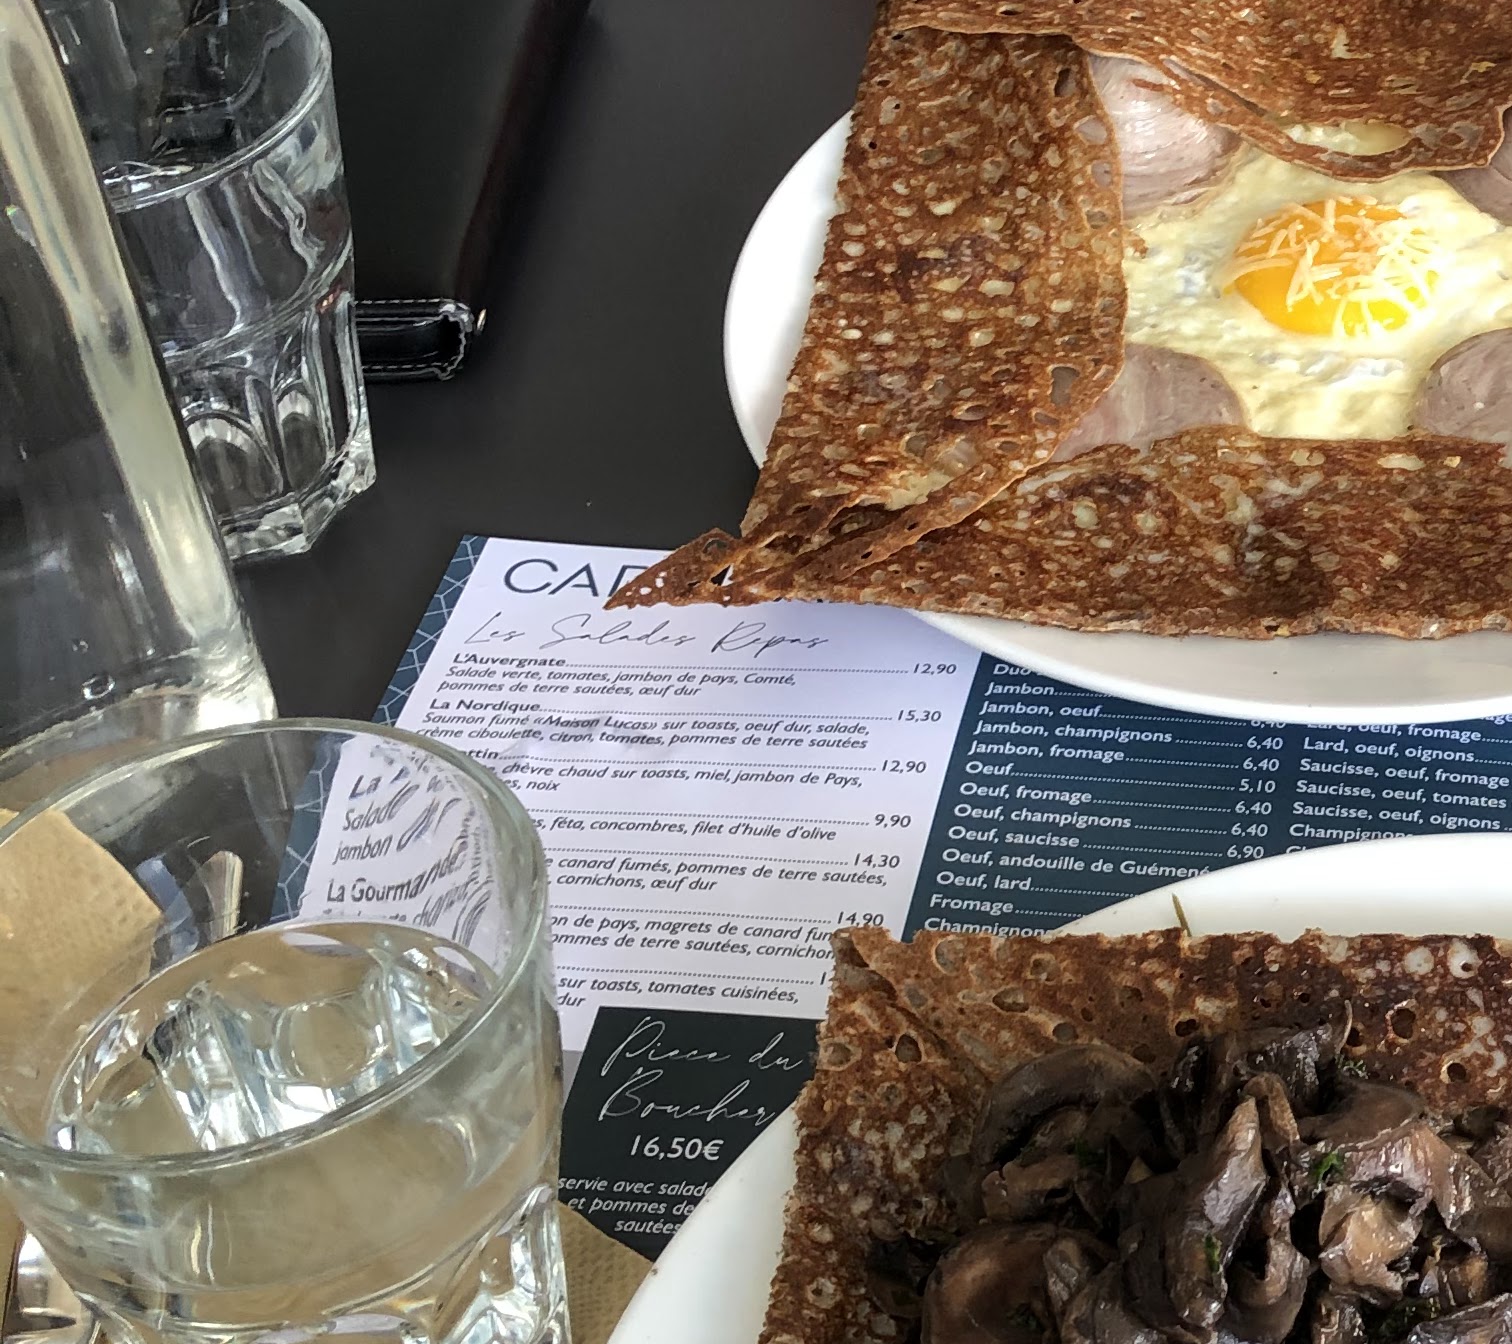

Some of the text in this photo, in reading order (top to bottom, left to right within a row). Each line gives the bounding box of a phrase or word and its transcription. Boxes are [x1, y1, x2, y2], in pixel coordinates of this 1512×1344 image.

[464, 611, 829, 659] Les Salades Repas
[446, 666, 797, 689] Salade verte, tomates, jambon de pays, Comté,
[913, 662, 957, 677] 12,90
[897, 709, 942, 724] 15,30
[974, 718, 1284, 752] Jambon, champignons 6,40
[1238, 778, 1276, 795] 5,10
[1299, 758, 1379, 778] Saucisse,
[1385, 764, 1429, 782] oeuf,
[1435, 768, 1510, 790] fromage
[953, 802, 1132, 832] Oeuf, champignons
[558, 855, 889, 887] canard fumés, pommes de terre sautées,
[851, 853, 901, 869] 14,30
[942, 847, 1113, 873] Oeuf, andouille de
[630, 1134, 725, 1162] 16,50€
[558, 1175, 654, 1194] servie avec
